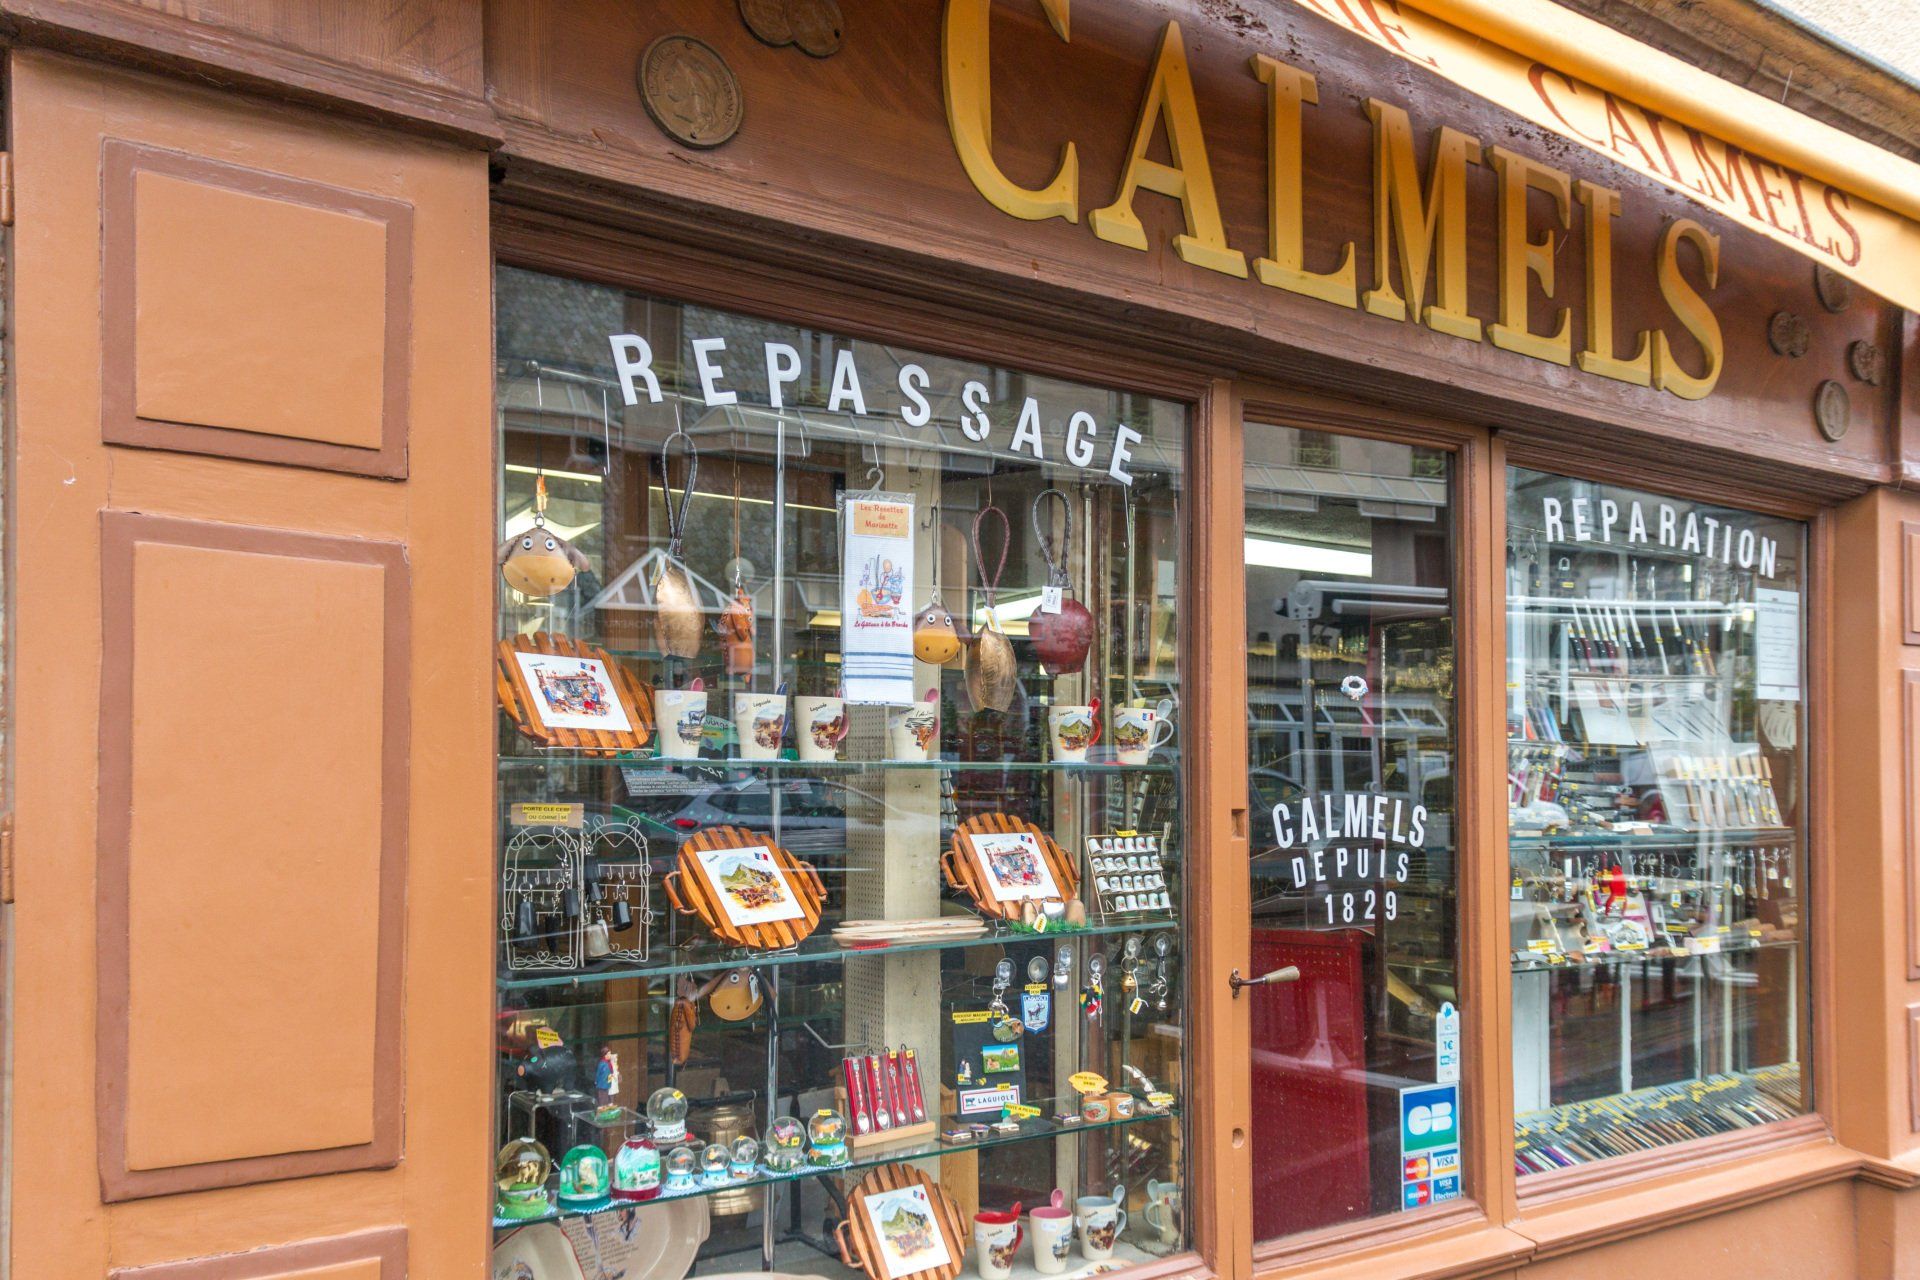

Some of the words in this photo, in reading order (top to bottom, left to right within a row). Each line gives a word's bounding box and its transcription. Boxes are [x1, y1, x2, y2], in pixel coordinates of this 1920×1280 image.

[1527, 62, 1862, 267] CALMELS
[942, 0, 1724, 400] CALMELS
[608, 333, 1142, 486] REPASSAGE
[1543, 497, 1777, 579] REPARATION
[1272, 793, 1428, 850] CALMELS
[1291, 846, 1410, 890] DEPUIS
[1325, 889, 1398, 925] 1829
[977, 1094, 1015, 1104] LAGUIOLE
[1408, 1102, 1453, 1136] CB
[1436, 1156, 1455, 1168] VISA
